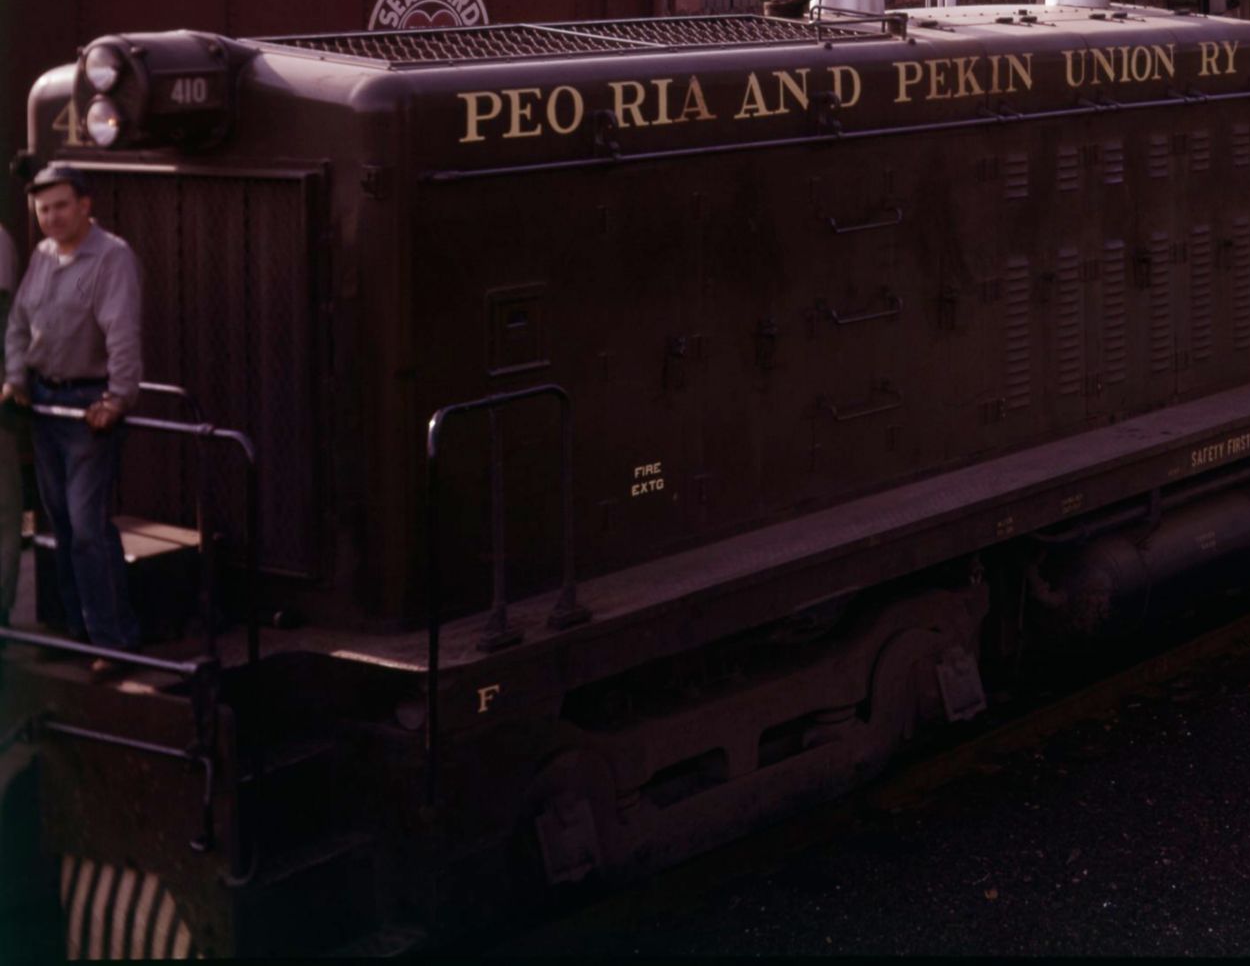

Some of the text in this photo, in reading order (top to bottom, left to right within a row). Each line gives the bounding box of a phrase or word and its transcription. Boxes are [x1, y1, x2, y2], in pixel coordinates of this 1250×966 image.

[171, 76, 208, 105] 410
[457, 40, 1240, 144] PEORIA AND PEKIN UNION RY
[1191, 433, 1250, 468] SAFETY FIRST
[633, 461, 663, 479] FIRE
[477, 684, 501, 714] F
